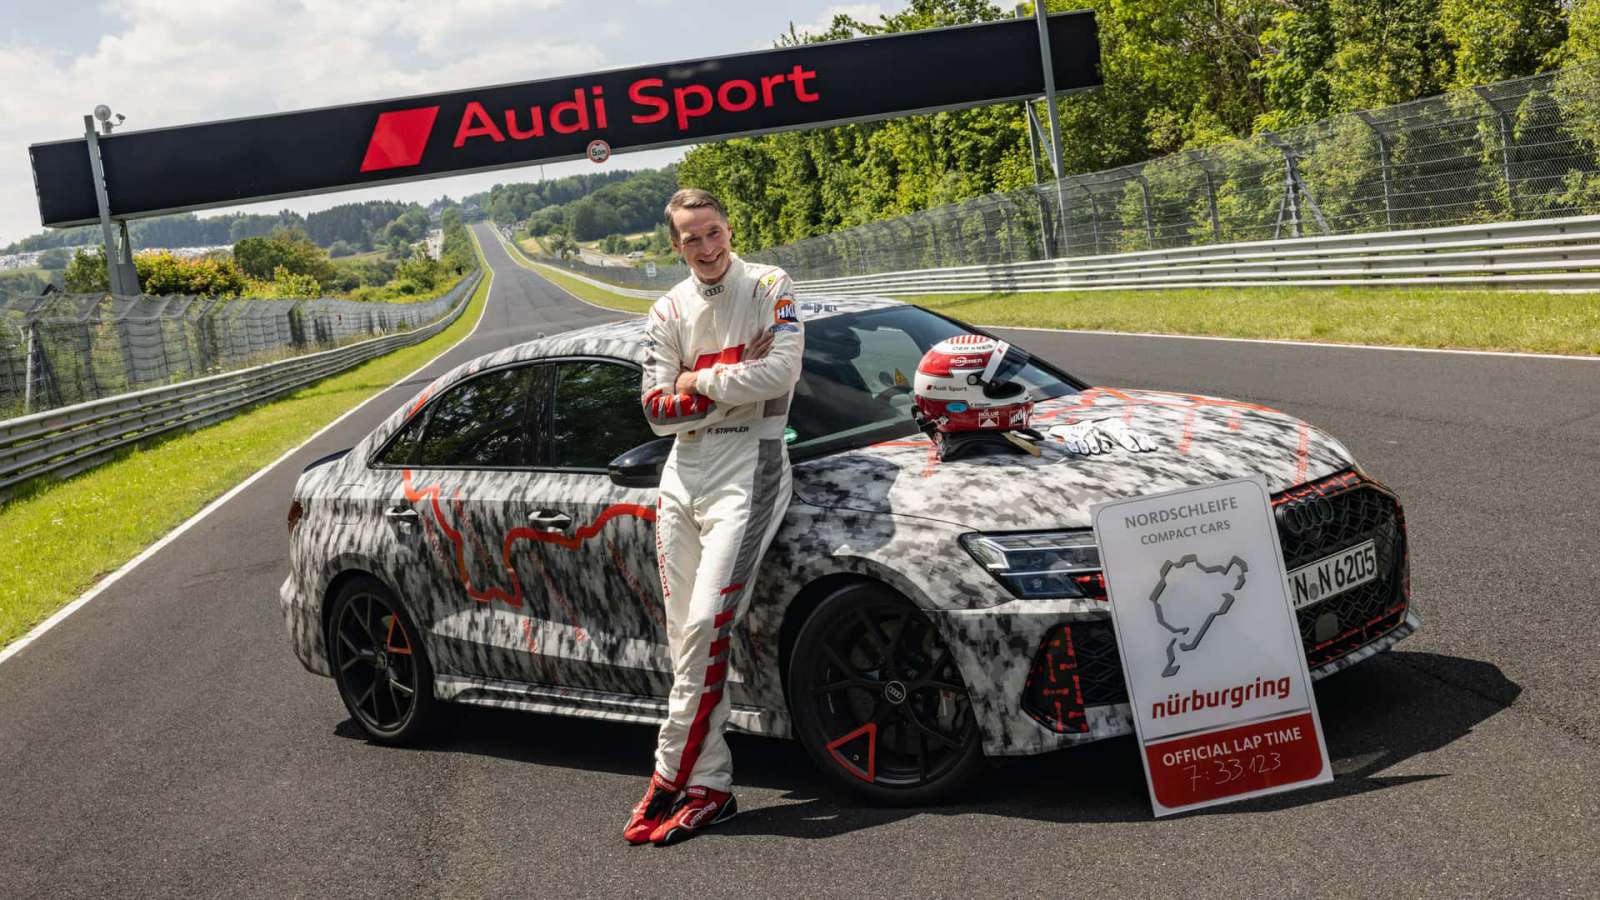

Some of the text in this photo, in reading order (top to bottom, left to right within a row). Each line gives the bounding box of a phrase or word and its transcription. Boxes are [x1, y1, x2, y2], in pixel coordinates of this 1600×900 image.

[453, 65, 819, 148] Audi Sport
[1124, 496, 1239, 529] NORDSCHLEIFE
[1140, 519, 1231, 545] COMPACT CARS
[1317, 563, 1333, 595] N
[1334, 545, 1376, 588] 6205
[1152, 675, 1291, 720] nürburgring
[1162, 727, 1303, 767] OFFICIAL LAP TIME
